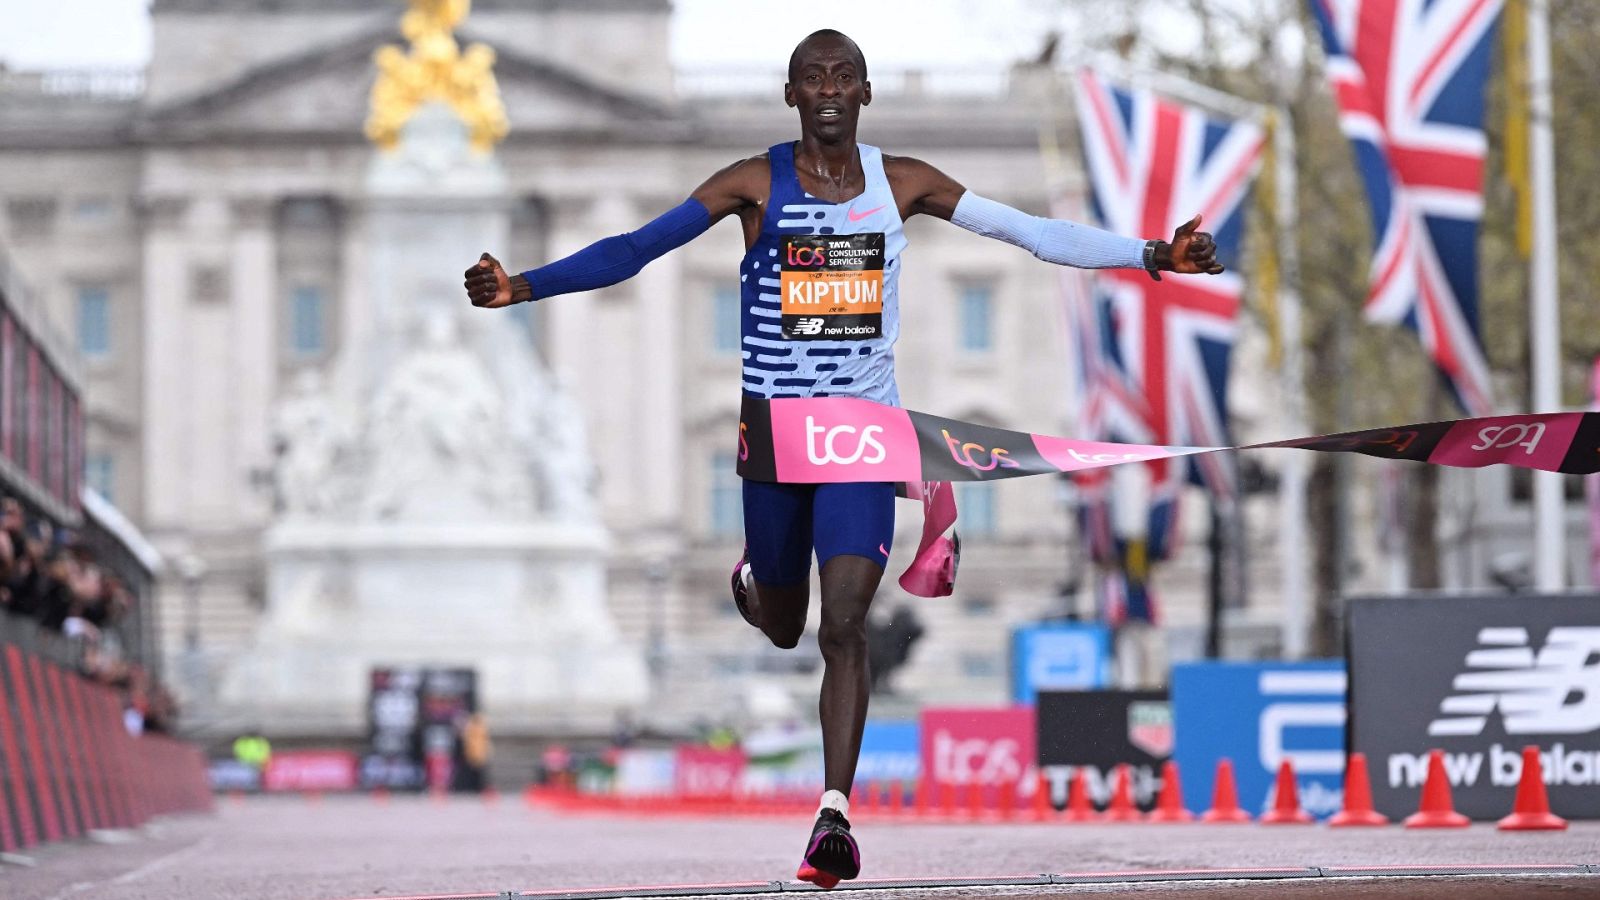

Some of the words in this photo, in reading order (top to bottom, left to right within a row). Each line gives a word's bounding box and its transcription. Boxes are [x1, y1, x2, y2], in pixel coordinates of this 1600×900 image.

[788, 241, 825, 266] tcs
[828, 241, 851, 249] TATA
[828, 249, 880, 257] CONSULTANCY
[828, 258, 863, 266] SERVICES
[788, 280, 878, 304] KIPTUM
[824, 327, 843, 335] new
[844, 325, 876, 335] balance
[806, 415, 887, 466] tcs
[941, 429, 1020, 471] tcs
[1471, 422, 1546, 455] tcs
